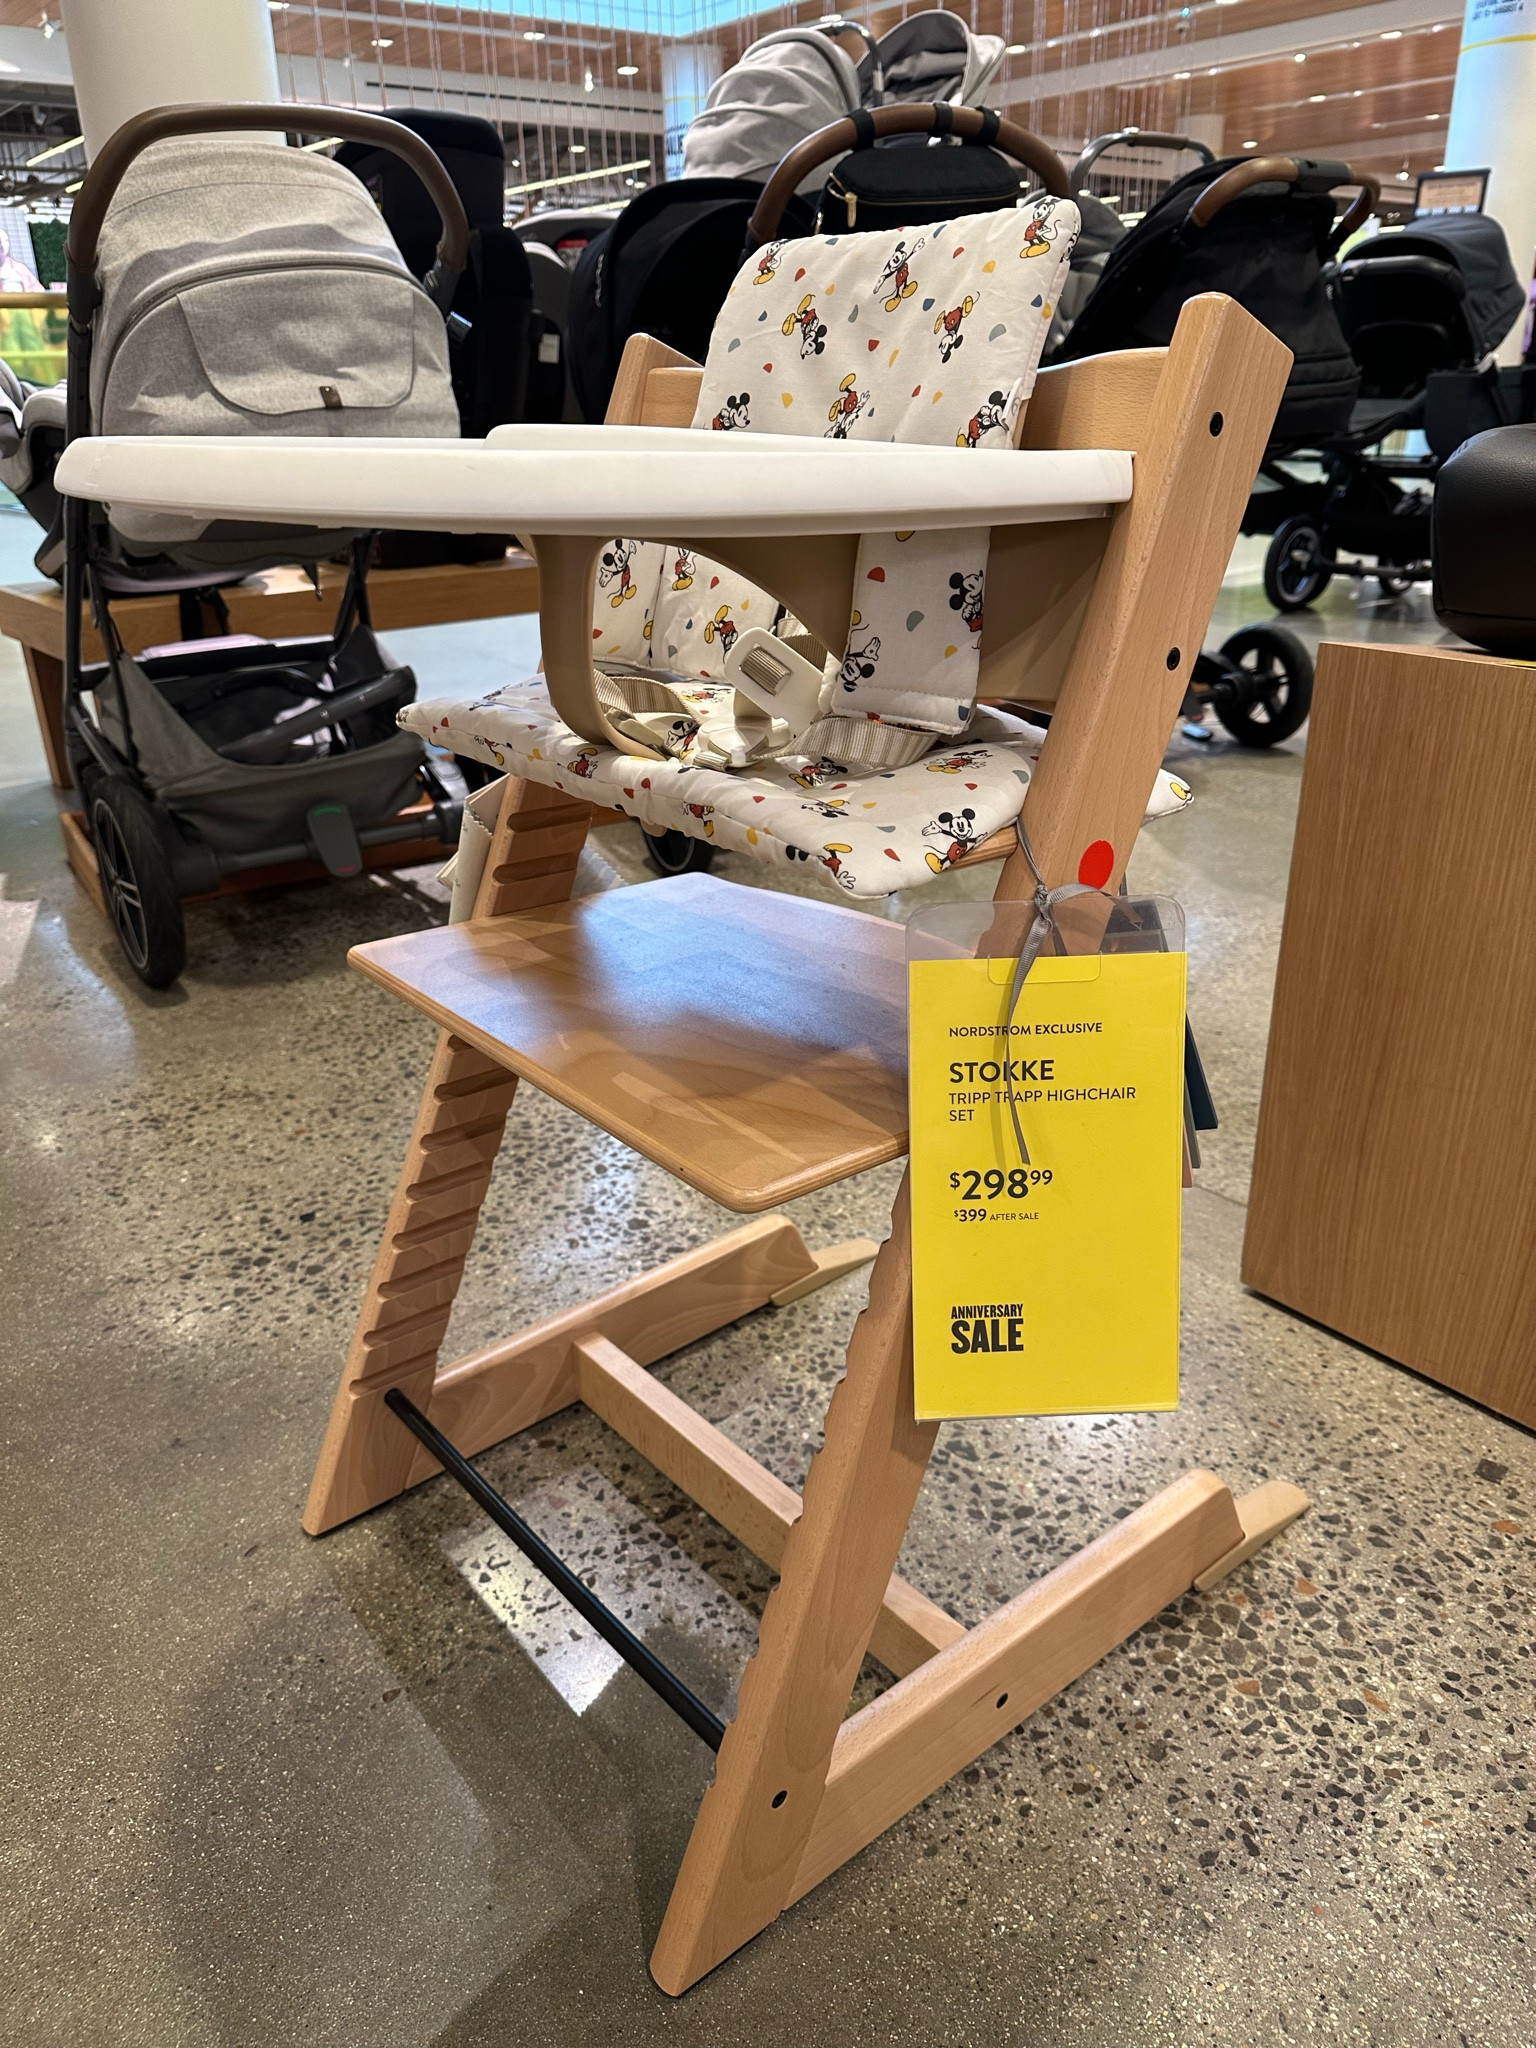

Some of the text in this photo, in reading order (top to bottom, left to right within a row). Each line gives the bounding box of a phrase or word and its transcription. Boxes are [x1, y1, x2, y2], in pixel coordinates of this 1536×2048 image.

[949, 1022, 1103, 1038] NORDSTROM EXCLUSIVE
[949, 1059, 1055, 1084] STOKKE
[949, 1087, 1136, 1105] TRIPP TRAPP HIGHCHAIR
[949, 1109, 975, 1122] SET
[953, 1208, 1040, 1222] $399 AFTER SALE
[951, 1303, 1024, 1320] ANNIVERSARY
[951, 1318, 1024, 1355] SALE
